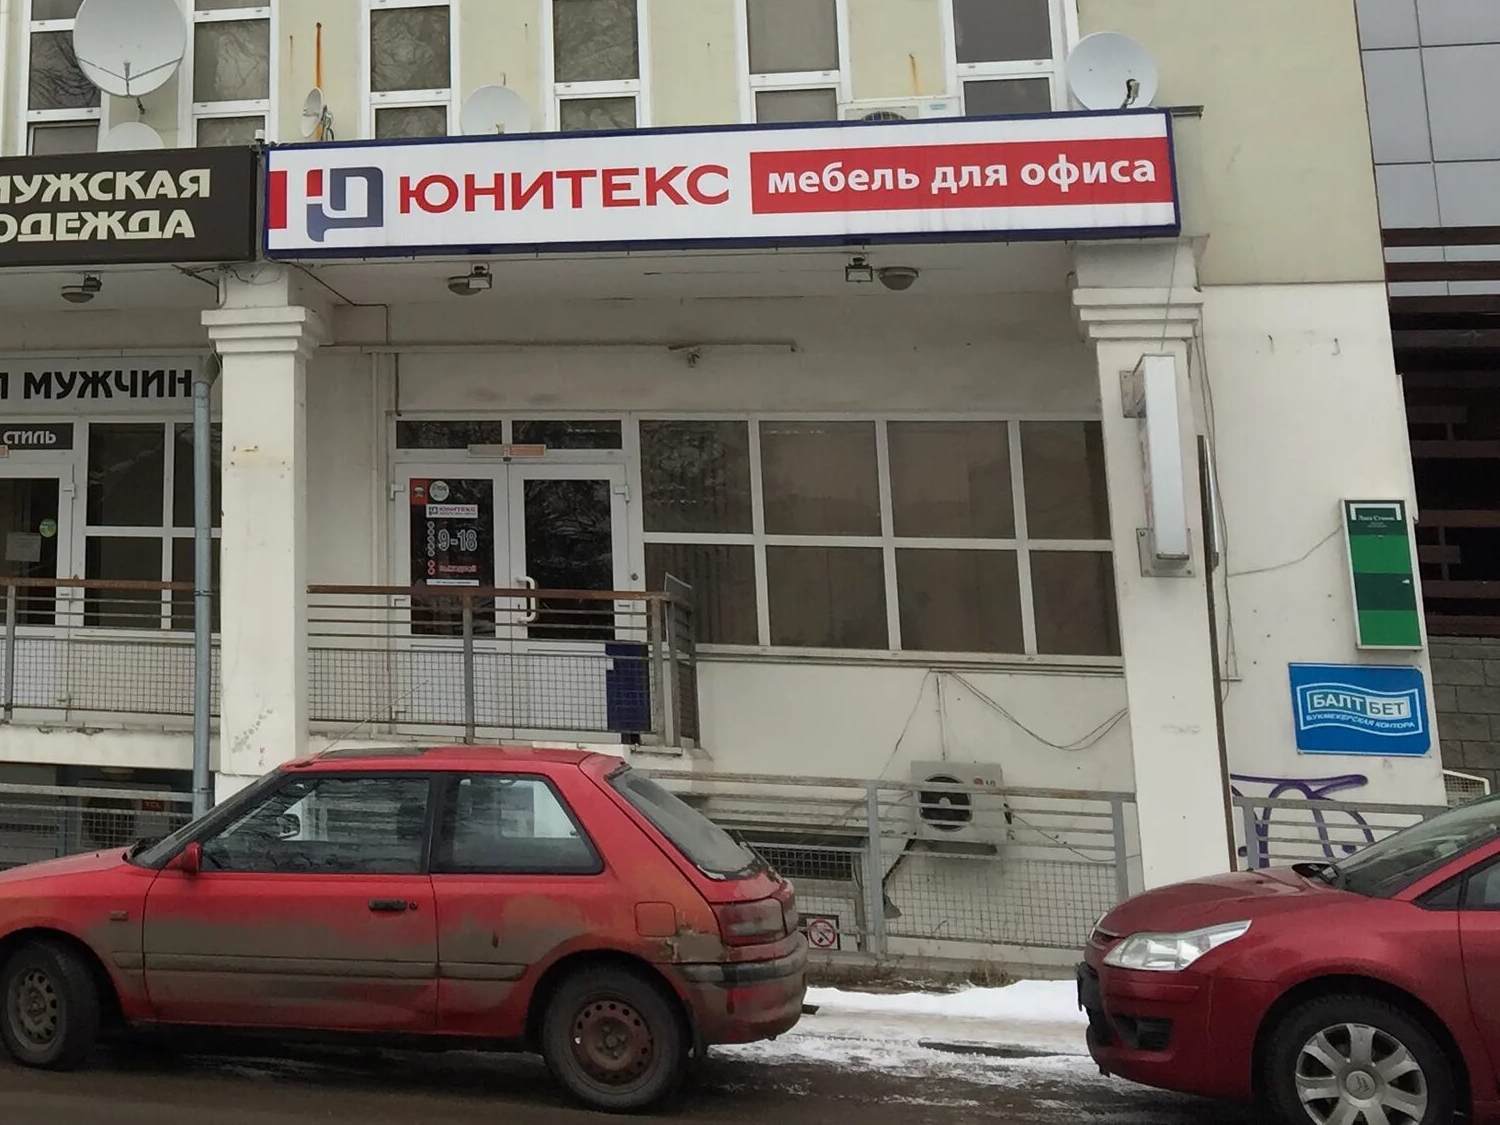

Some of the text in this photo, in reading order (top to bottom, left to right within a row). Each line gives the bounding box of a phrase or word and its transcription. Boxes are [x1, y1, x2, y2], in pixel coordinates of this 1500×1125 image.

[767, 149, 1157, 195] мебель для офиса
[399, 163, 729, 215] ЮНИТЕКС
[24, 368, 194, 400] МУЖЧИН
[2, 428, 56, 445] СТИЛЬ
[438, 529, 478, 551] 9-18
[1306, 713, 1416, 729] БУКМЕКЕРСКАЯ КОНТОРА
